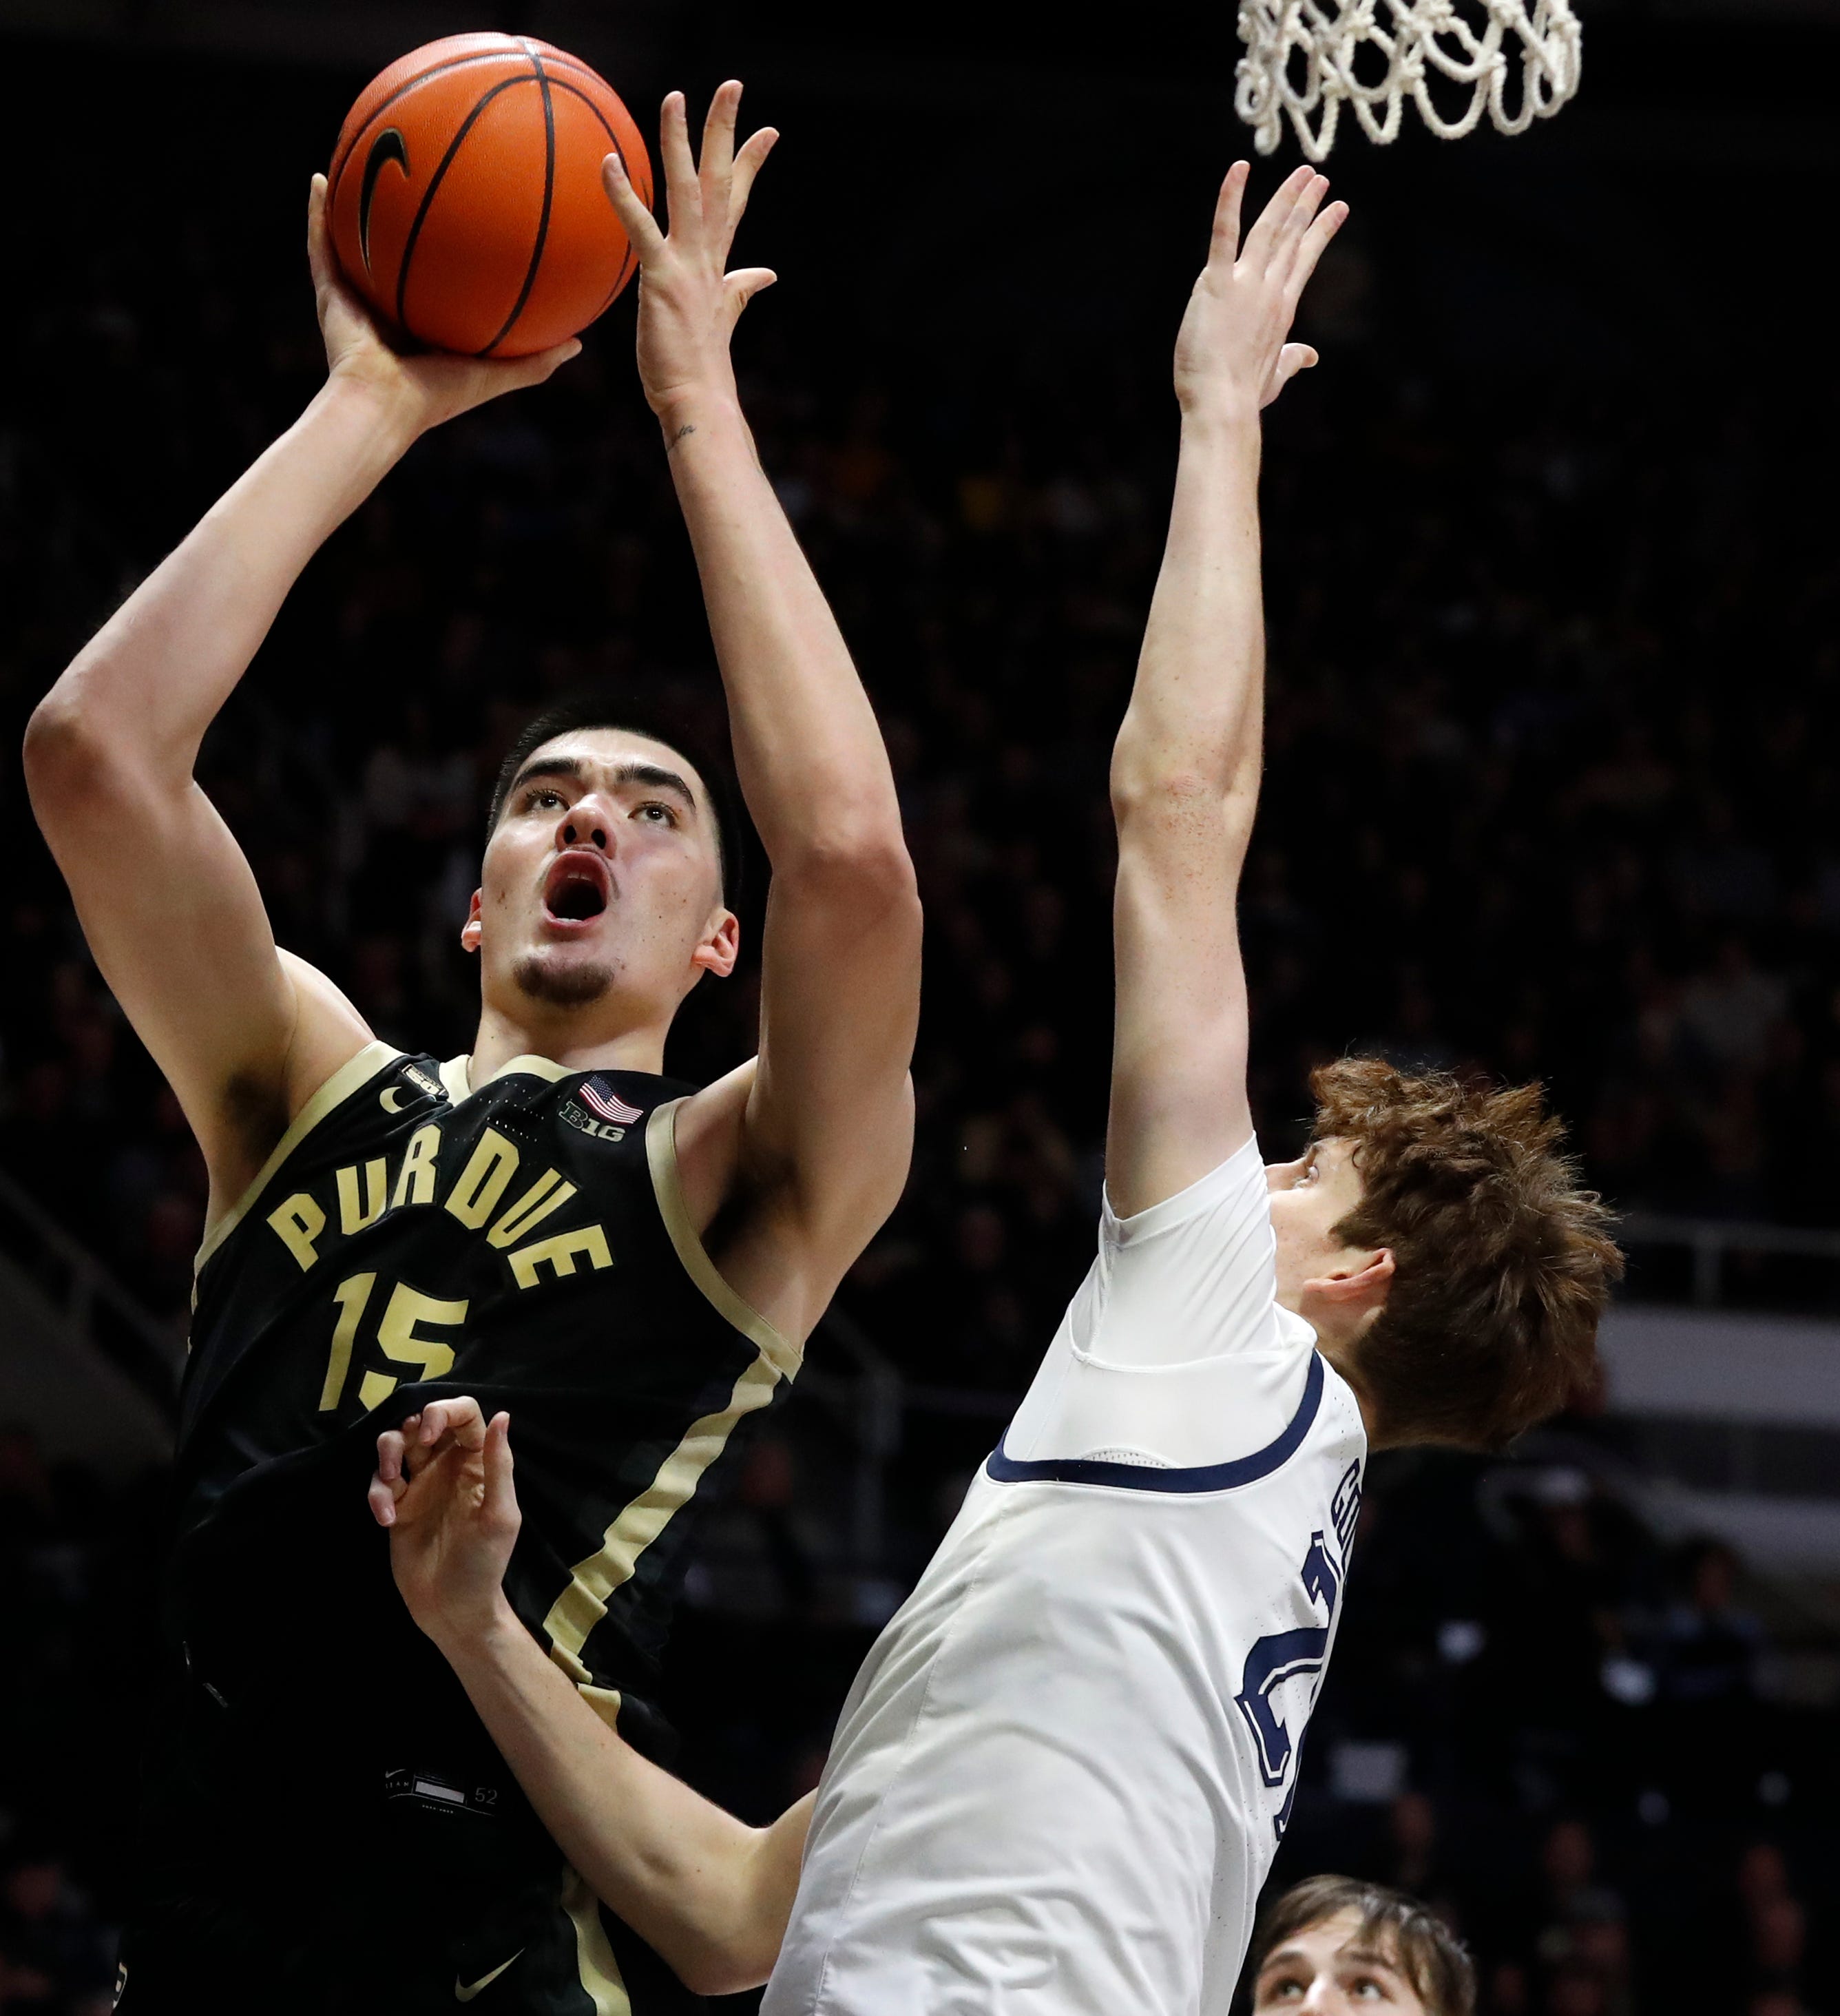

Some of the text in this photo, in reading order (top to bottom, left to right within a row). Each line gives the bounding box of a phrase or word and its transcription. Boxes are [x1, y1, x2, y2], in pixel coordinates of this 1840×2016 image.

[266, 1123, 614, 1290] PURDUE
[318, 1272, 470, 1411] 15
[475, 1787, 497, 1805] 52
